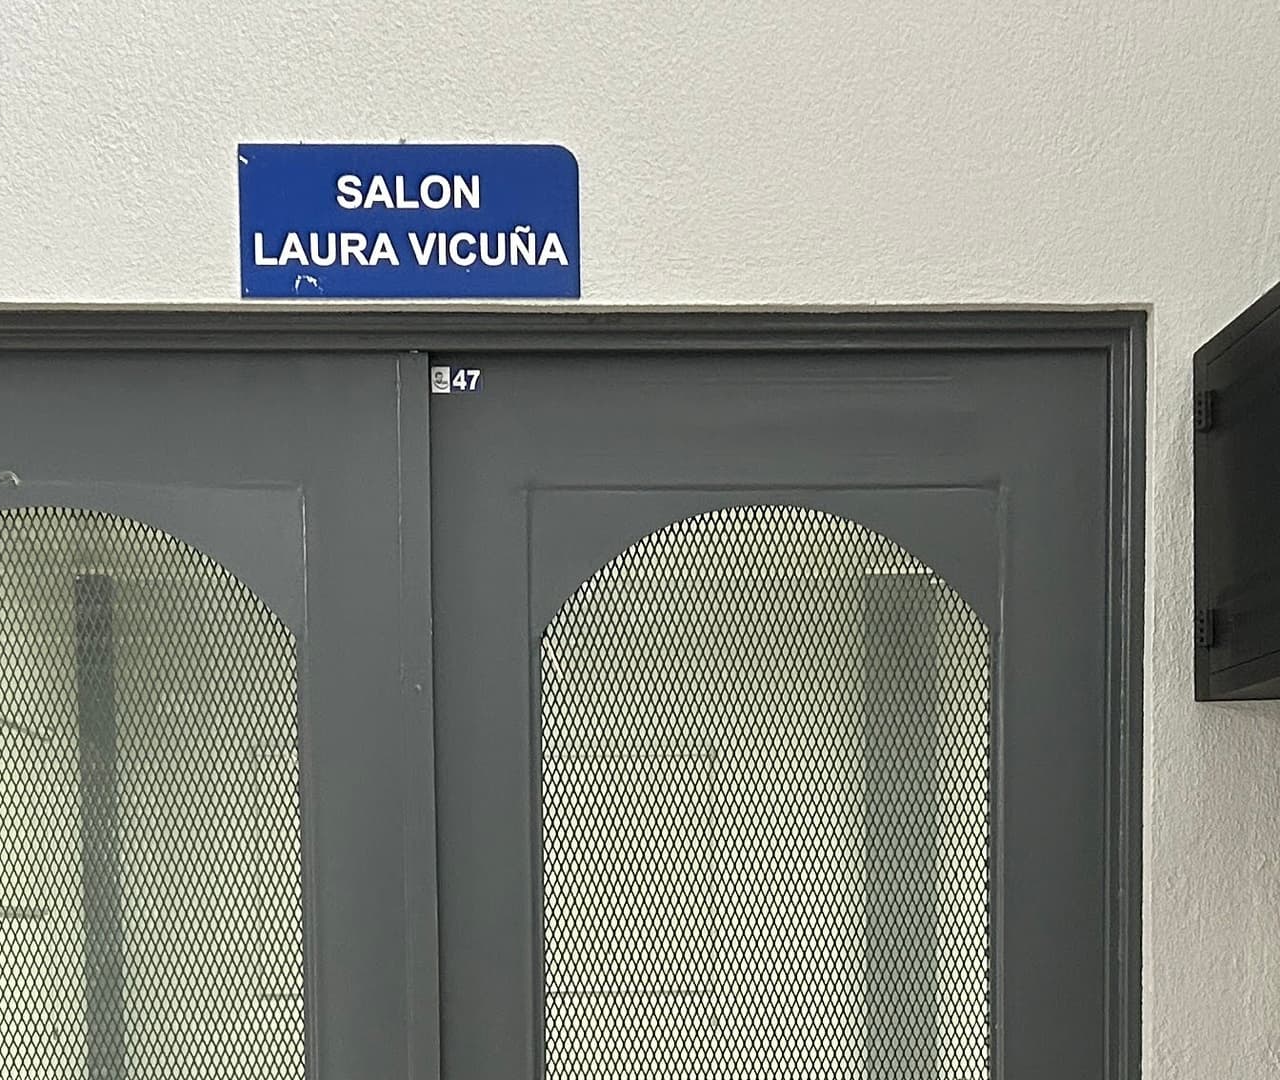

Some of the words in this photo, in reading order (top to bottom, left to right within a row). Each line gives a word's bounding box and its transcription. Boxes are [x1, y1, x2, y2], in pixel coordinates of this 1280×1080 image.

[336, 175, 480, 209] SALON
[254, 232, 399, 266] LAURA
[409, 225, 568, 267] VICUÑA
[452, 369, 480, 390] 47
